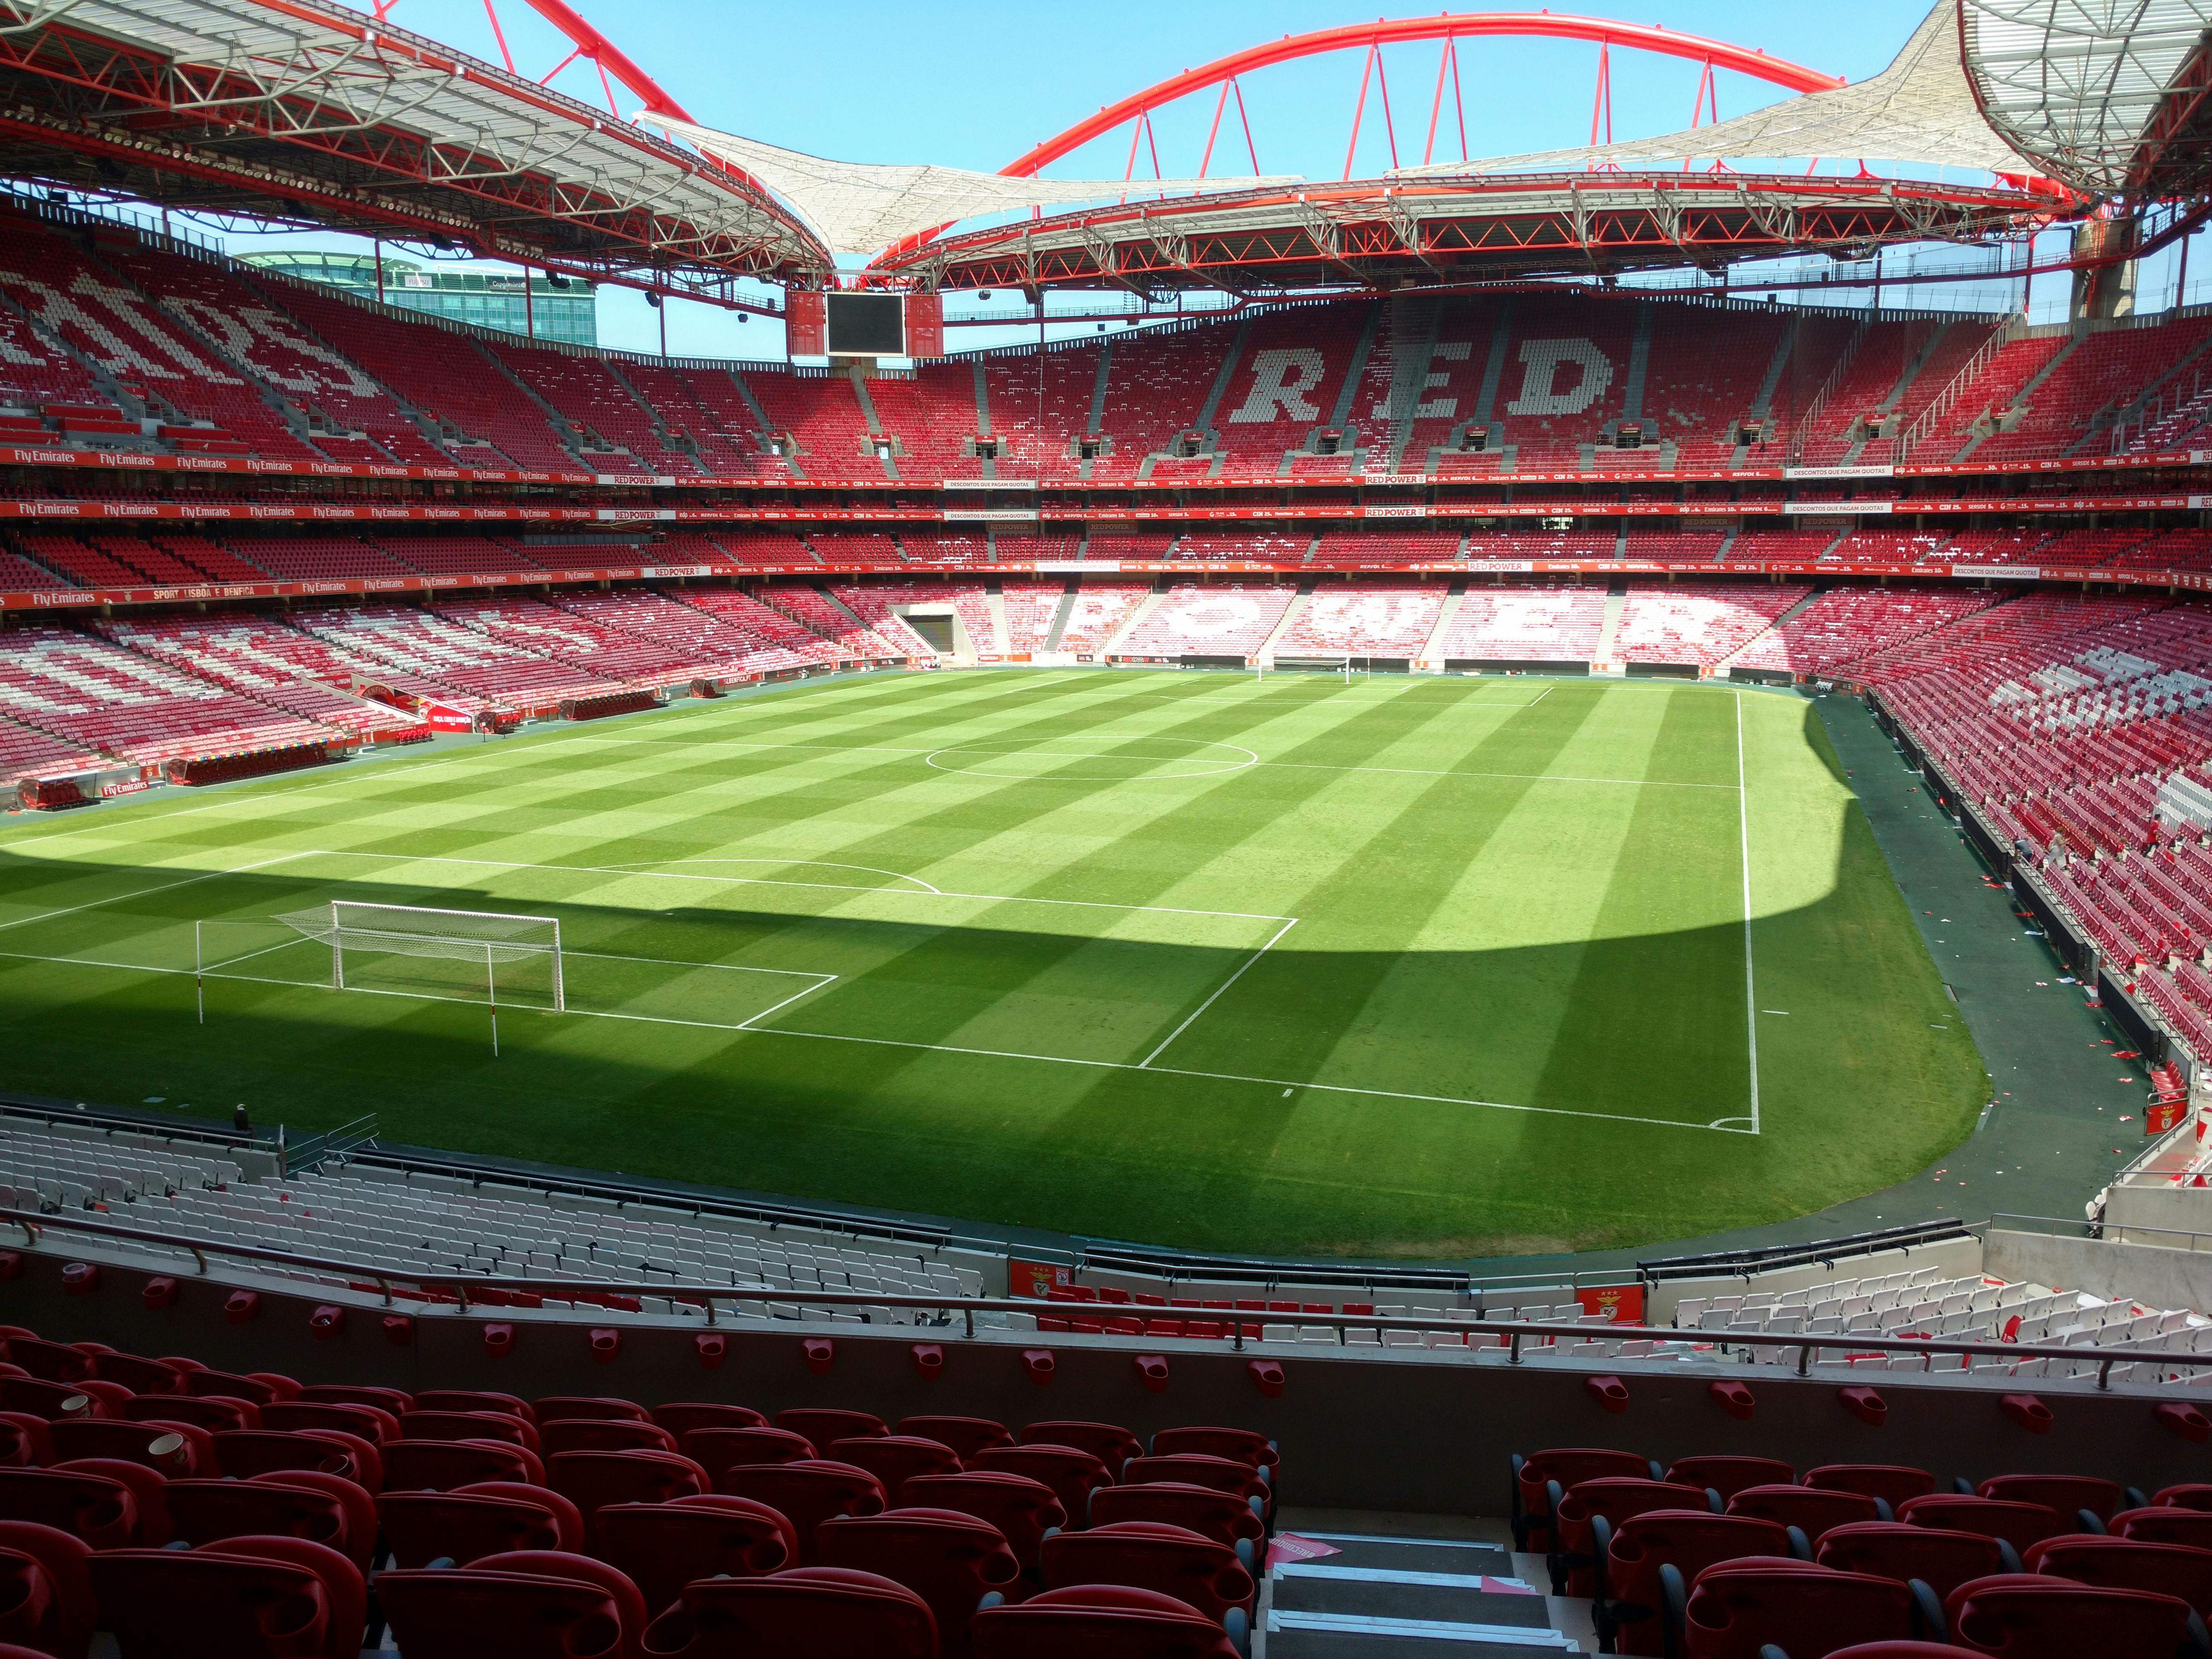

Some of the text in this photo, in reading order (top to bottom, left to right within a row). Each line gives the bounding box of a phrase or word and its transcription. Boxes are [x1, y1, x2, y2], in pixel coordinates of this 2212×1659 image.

[15, 450, 75, 463] Fly Emirates
[100, 453, 154, 466] Fly Emirates
[177, 457, 226, 469] Fly Emirates
[247, 460, 292, 471] Fly Emirates
[311, 462, 353, 474] Fly Emirates
[370, 465, 408, 476] Fly Emirates
[423, 468, 458, 477] Fly Emirates
[473, 470, 482, 480] Fly
[519, 472, 527, 481] Fly
[19, 503, 79, 516] Fly Emirates
[104, 504, 158, 517] Fly Emirates
[181, 507, 230, 517] Fly Emirates
[250, 506, 295, 518] Fly Emirates
[313, 507, 354, 518] Fly Emirates
[371, 507, 409, 518] Fly Emirates
[425, 508, 435, 519] Fly
[474, 509, 506, 519] Fly Emirates
[520, 510, 550, 519] Fly Emirates
[570, 510, 590, 519] Emirates
[420, 577, 457, 588] Fly Emirates
[473, 575, 507, 585] Fly Emirates
[520, 574, 529, 583] Fly
[565, 572, 574, 582] Fly
[302, 582, 346, 594] Fly Emirates
[364, 579, 404, 591] Fly Emirates
[33, 592, 95, 606] Fly Emirates
[154, 587, 254, 600] SPORT LISBOA E BENFICA
[117, 781, 147, 793] Emirates
